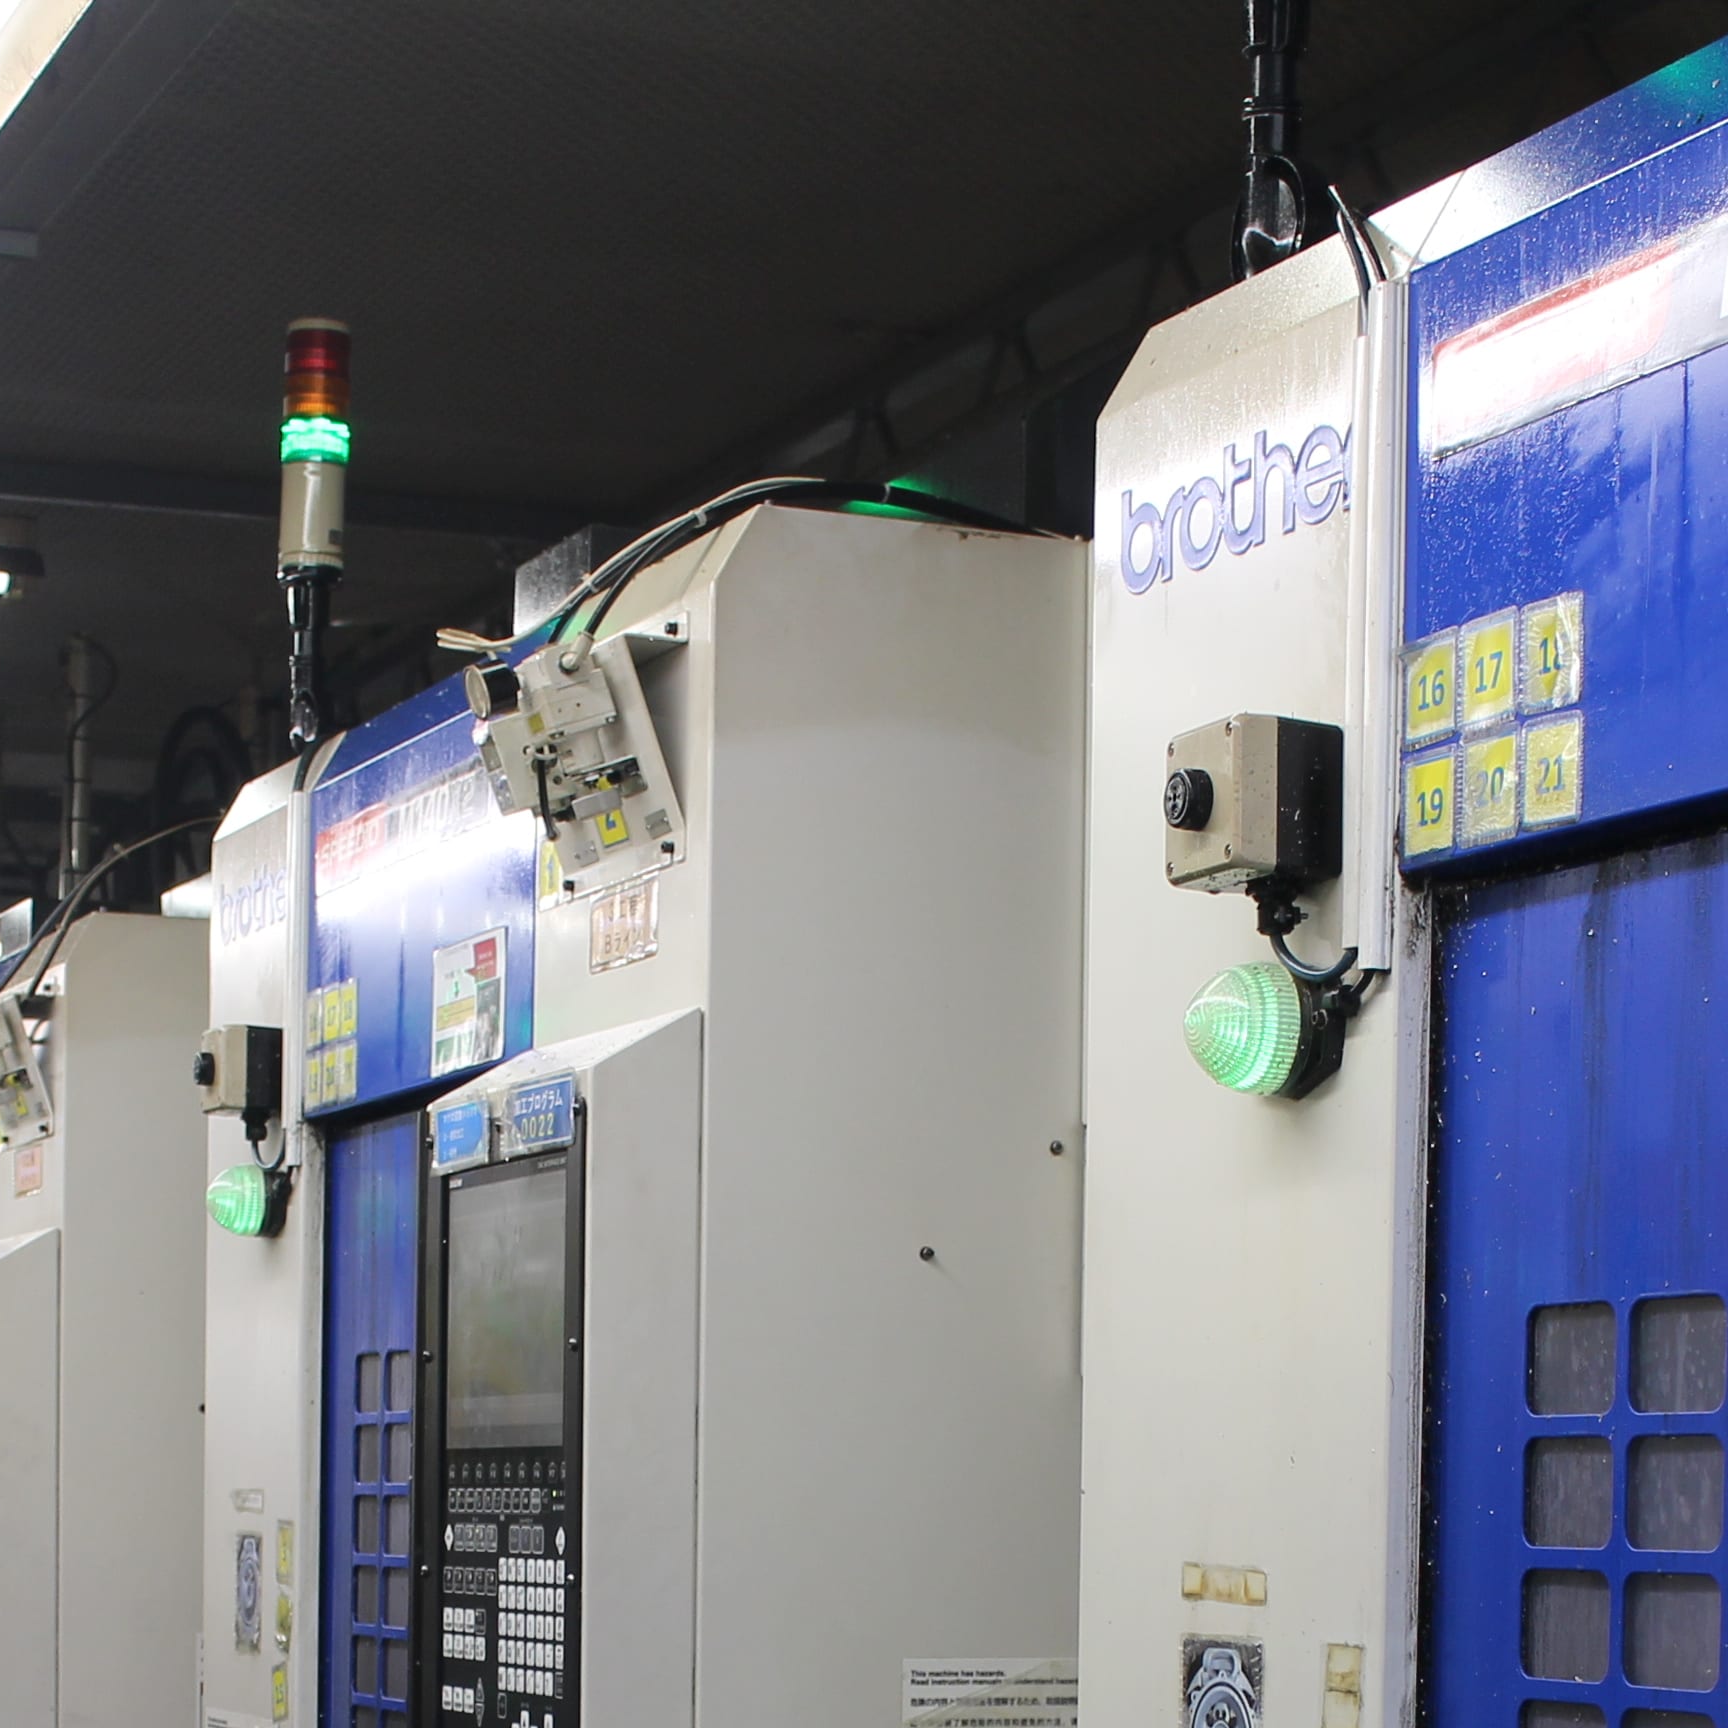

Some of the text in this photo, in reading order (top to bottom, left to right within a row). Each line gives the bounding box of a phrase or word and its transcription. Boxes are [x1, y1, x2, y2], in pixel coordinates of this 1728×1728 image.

[1418, 669, 1445, 709] 16
[1475, 652, 1503, 692] 17
[1476, 767, 1505, 808] 20
[1537, 754, 1565, 793] 21
[1417, 787, 1442, 827] 19
